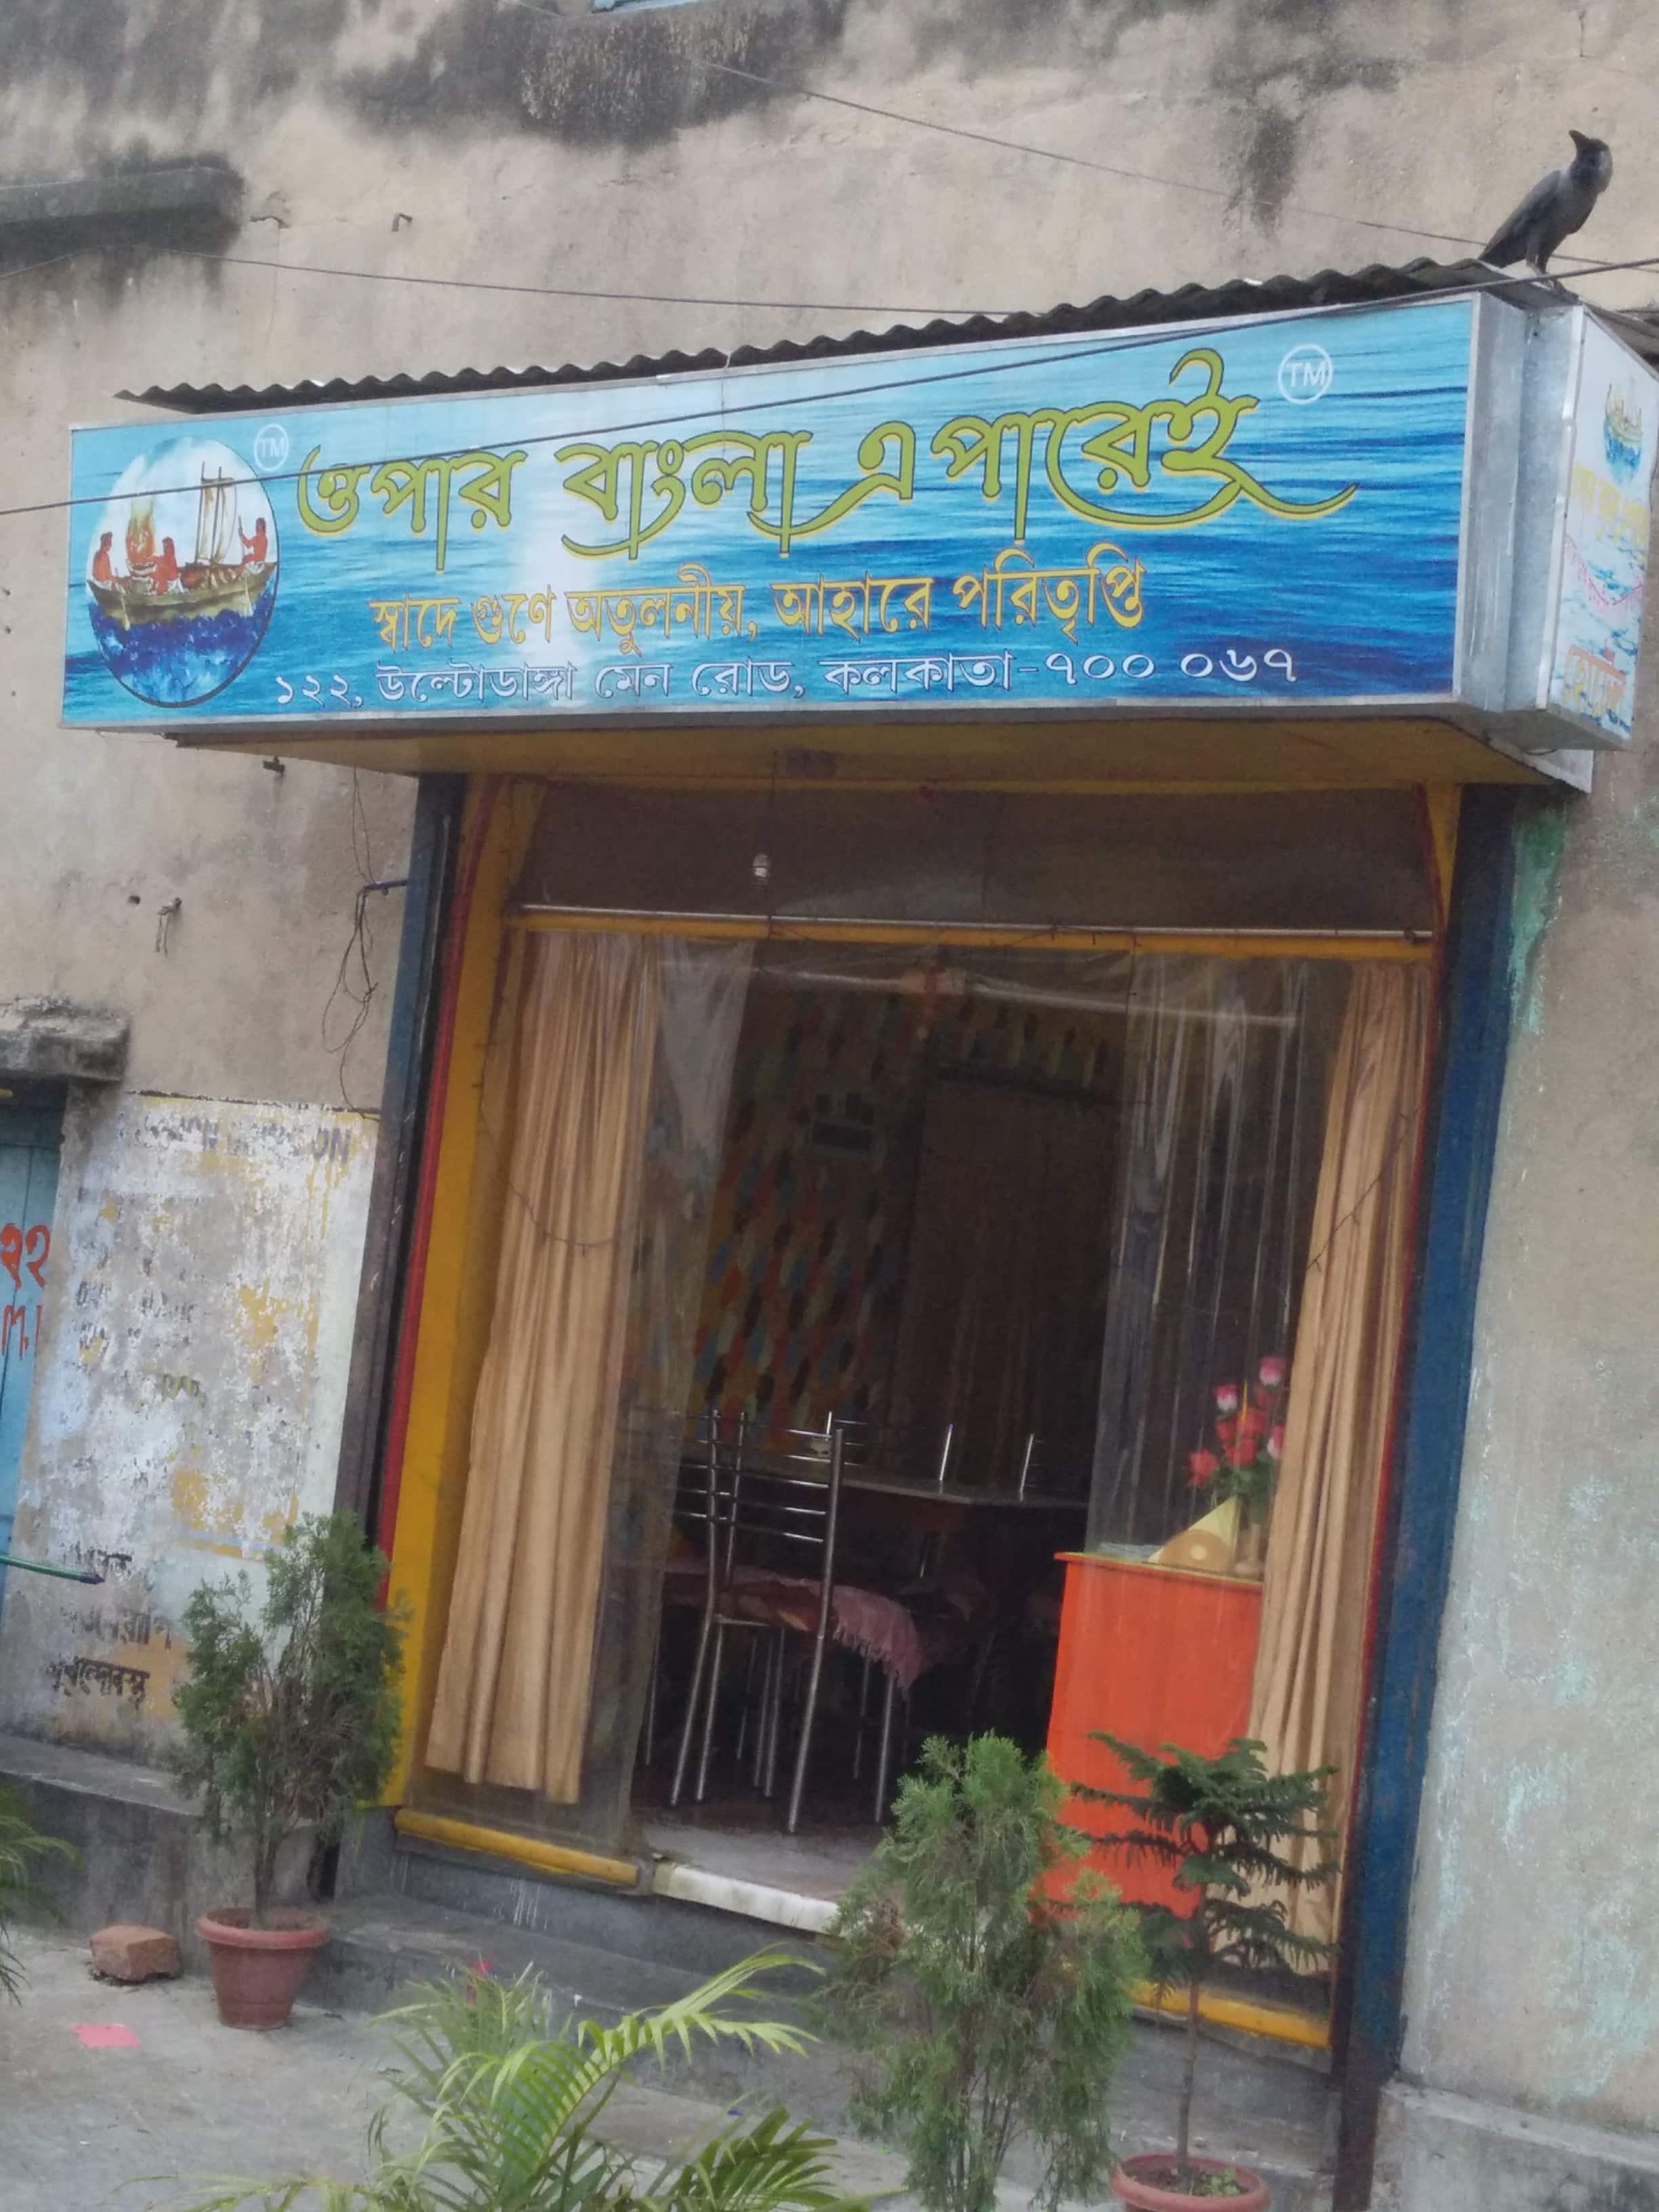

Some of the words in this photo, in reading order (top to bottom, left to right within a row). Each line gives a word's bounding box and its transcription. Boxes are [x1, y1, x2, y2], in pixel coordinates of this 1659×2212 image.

[1288, 362, 1326, 387] TM
[297, 445, 527, 574] ওপার
[554, 429, 813, 561] বাংলা
[368, 592, 462, 653] স্বাদে
[470, 583, 556, 645] গুণে
[564, 563, 758, 657] অতুলনীয়,
[771, 569, 935, 643] আহারে
[952, 541, 1147, 644] পরিতৃপ্তি
[276, 673, 364, 708] ১২২,
[375, 658, 579, 703] উল্টোডাঙ্গা
[594, 661, 673, 698] মেন
[691, 657, 806, 699] রোড,
[1180, 647, 1297, 684] ০৬৭
